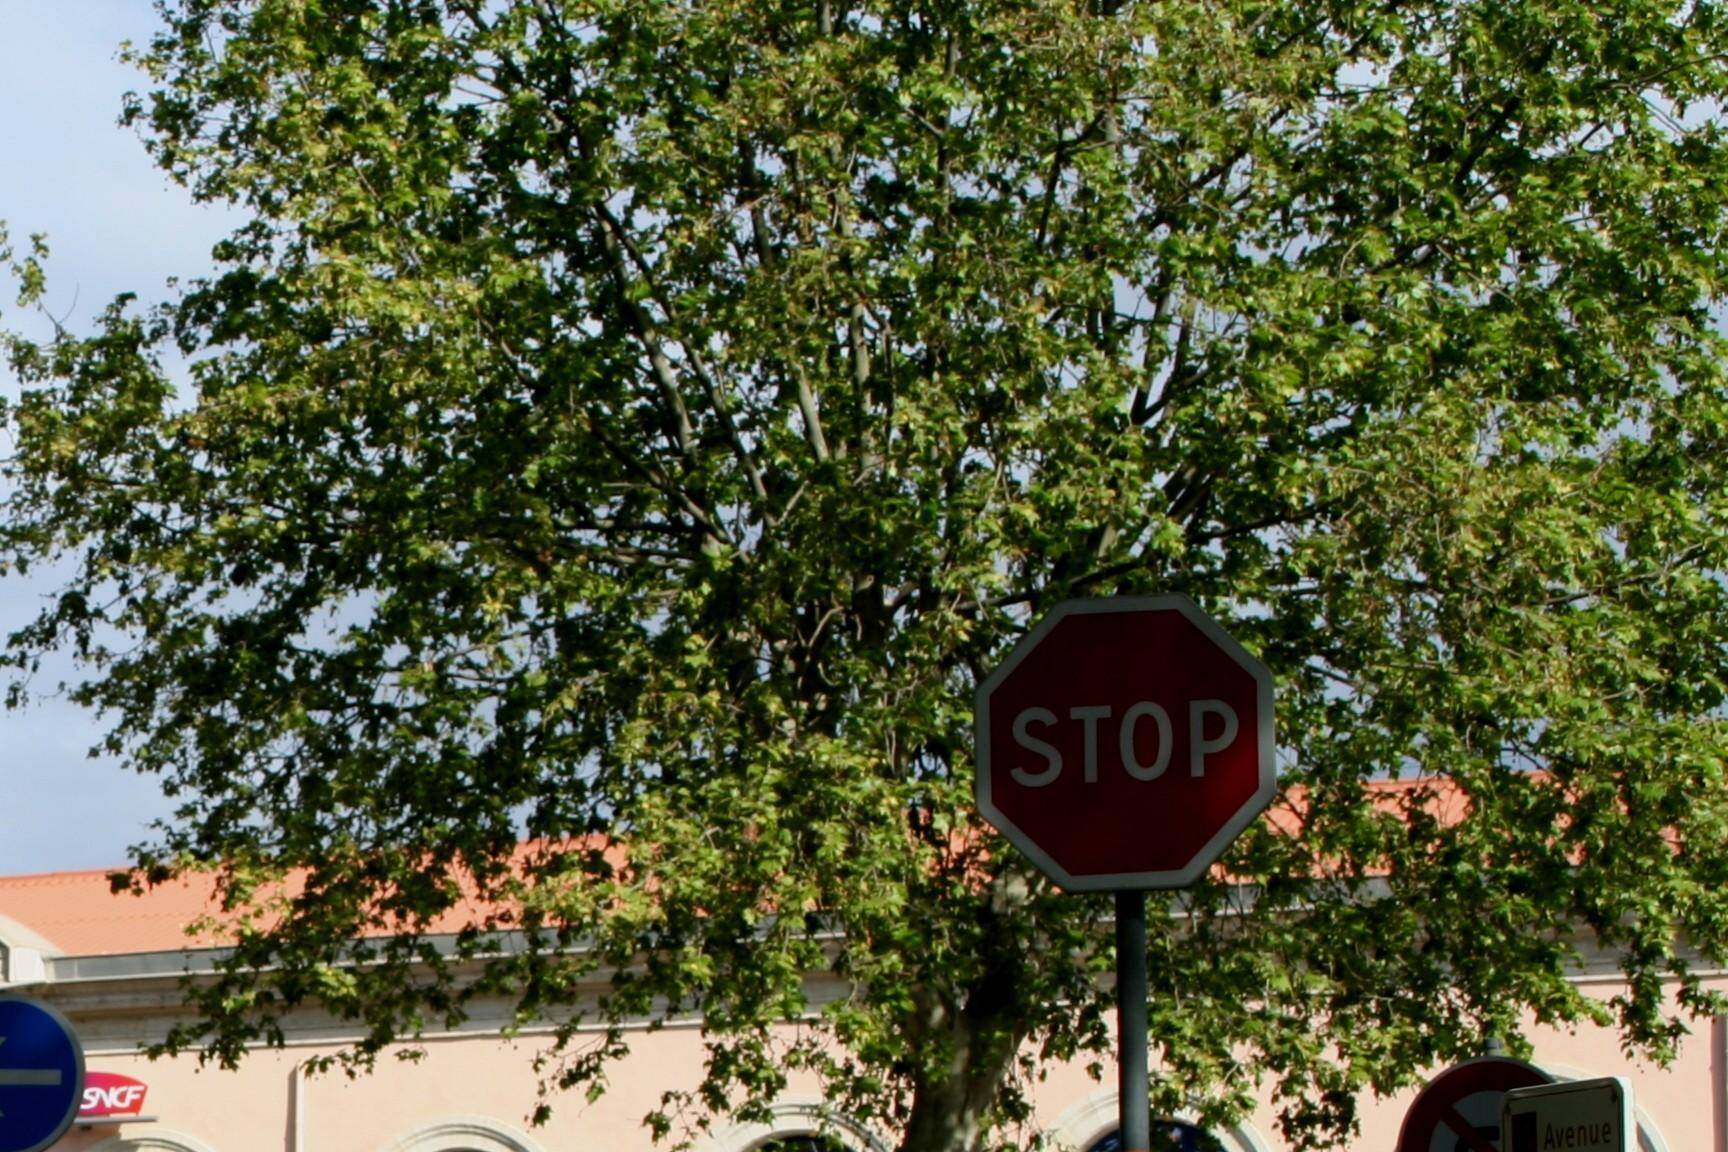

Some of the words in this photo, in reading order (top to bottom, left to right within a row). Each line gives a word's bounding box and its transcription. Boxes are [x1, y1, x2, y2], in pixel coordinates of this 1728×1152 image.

[1010, 699, 1239, 788] STOP
[80, 1086, 145, 1110] SNCF
[1544, 1121, 1612, 1151] Avenue
